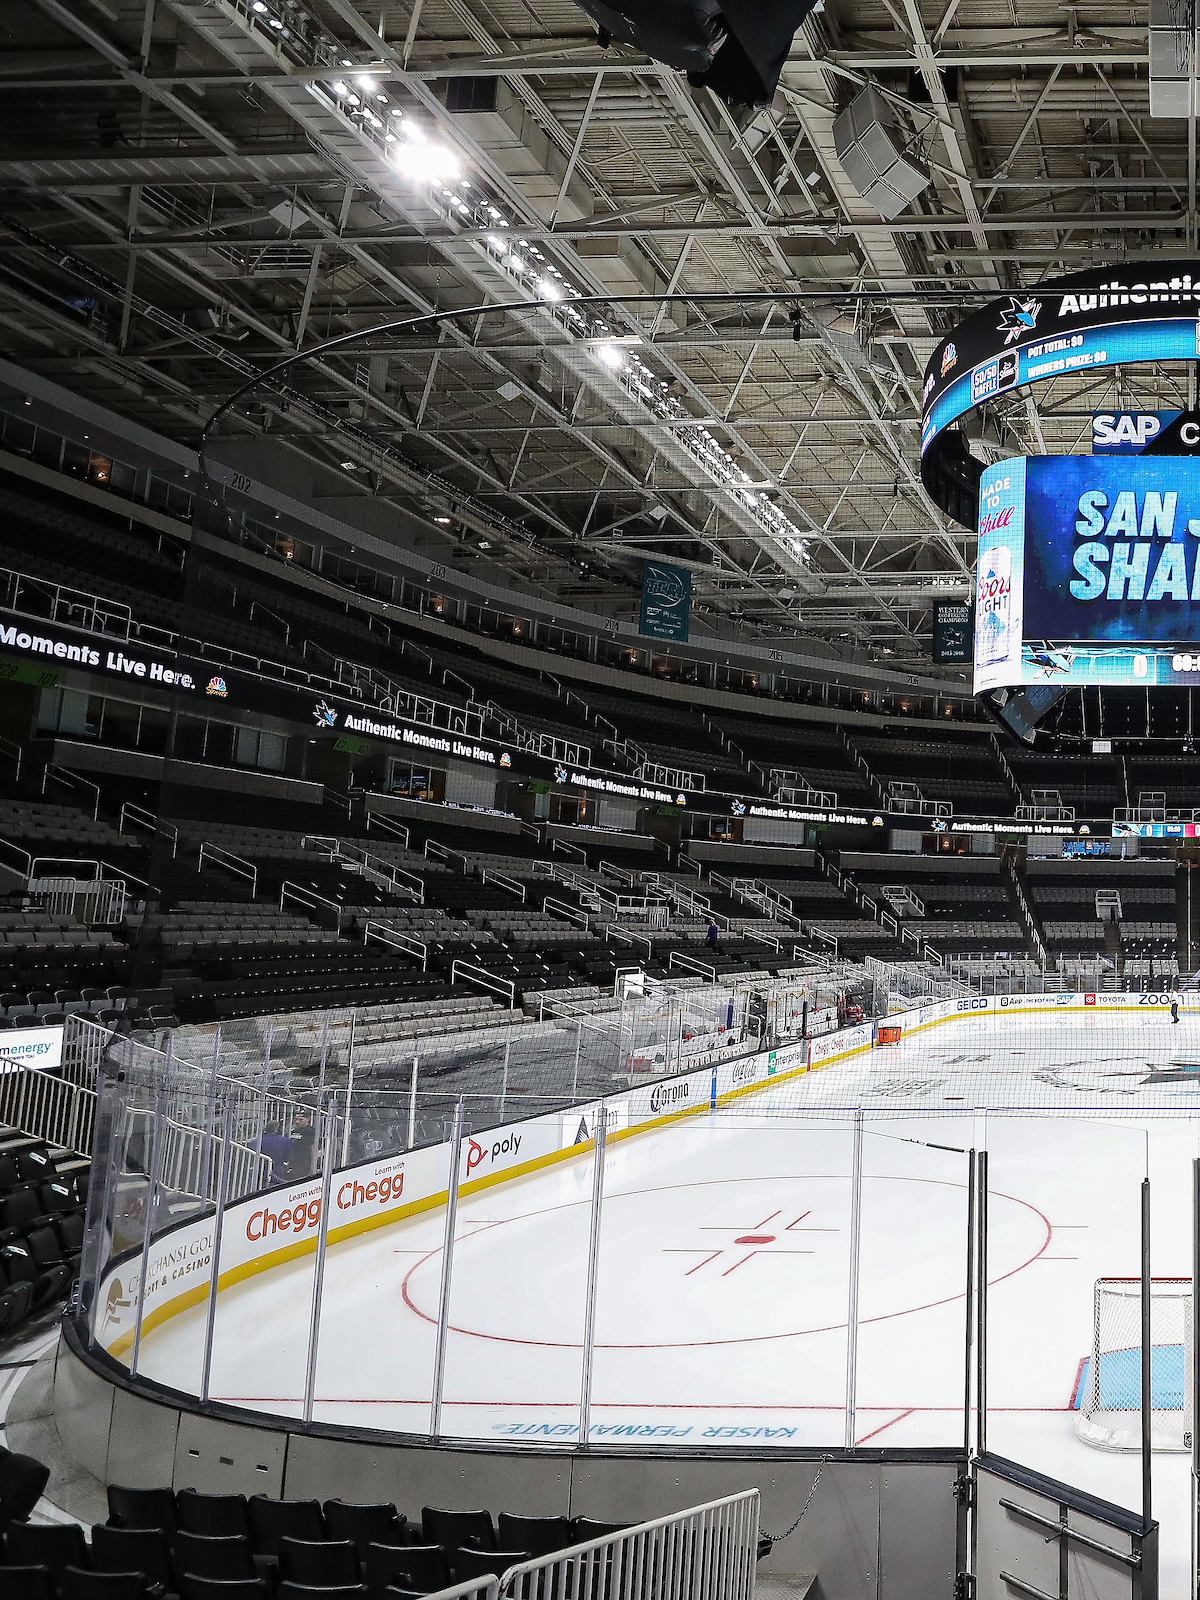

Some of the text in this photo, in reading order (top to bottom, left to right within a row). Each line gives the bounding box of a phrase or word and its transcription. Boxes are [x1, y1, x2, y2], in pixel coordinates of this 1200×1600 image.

[1027, 334, 1084, 359] POT TOTAL: $0
[974, 364, 997, 385] 50/50
[1027, 361, 1065, 379] WINNERS
[1066, 354, 1093, 368] PRIZE:
[974, 378, 997, 398] RAFFLE
[1093, 415, 1160, 445] SAP
[231, 472, 250, 494] 202
[982, 478, 1011, 500] MADE
[986, 495, 1001, 510] TO
[1075, 490, 1178, 537] SAN
[979, 507, 1015, 538] Chill
[431, 562, 446, 579] 203
[978, 576, 1011, 602] Coors
[0, 624, 195, 690] Moments Live Here.
[768, 649, 783, 661] 205
[1133, 655, 1148, 678] 0
[38, 672, 58, 686] 101
[206, 685, 229, 698] Sports
[344, 714, 496, 764] Authentic Moments Live Here.
[570, 773, 673, 803] Authentic Moments Live Here.
[749, 806, 868, 825] Authentic Moments Live Here.
[951, 822, 1075, 834] Authentic Moments Live Here.
[1145, 824, 1153, 837] 0
[957, 998, 988, 1011] GEICO
[1009, 997, 1022, 1005] App
[1057, 996, 1071, 1004] SAP
[770, 1052, 801, 1069] enterpris
[650, 1082, 689, 1113] Corona
[491, 1132, 522, 1163] poly
[374, 1161, 405, 1175] Learn with
[288, 1186, 322, 1202] Learn with
[337, 1172, 404, 1210] Chegg
[246, 1199, 321, 1241] Chegg
[128, 1234, 213, 1293] CHKCHANSI GOL
[161, 1255, 211, 1286] & CASINO
[702, 1425, 799, 1439] KAISER
